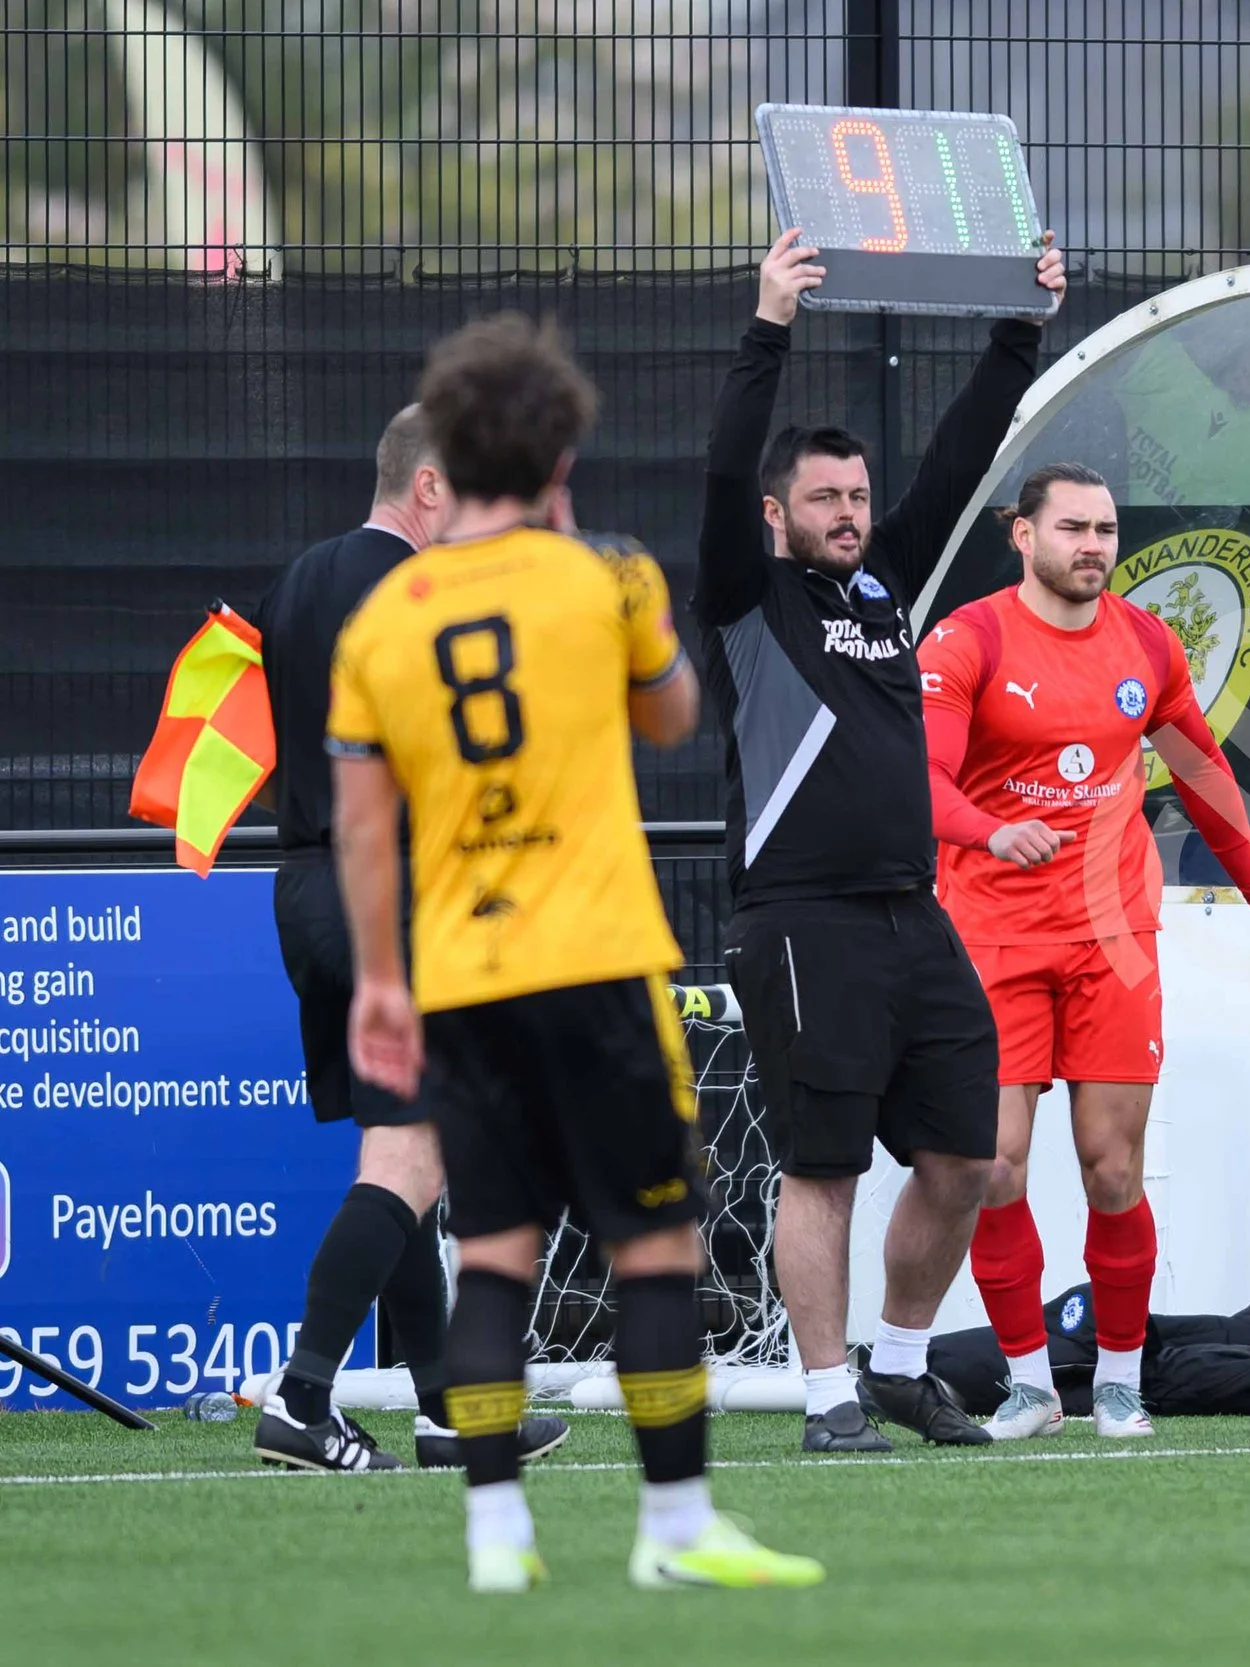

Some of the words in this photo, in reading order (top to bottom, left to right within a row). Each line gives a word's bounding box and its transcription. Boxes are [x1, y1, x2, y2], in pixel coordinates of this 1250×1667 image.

[831, 119, 908, 252] 9
[433, 614, 526, 765] 8
[1002, 776, 1070, 800] Andrew
[3, 905, 58, 943] and
[67, 904, 141, 942] build
[33, 962, 95, 1006] gain
[0, 1018, 140, 1062] cquisition
[33, 1071, 230, 1116] development
[239, 1070, 307, 1106] servi
[51, 1189, 277, 1249] Payehomes
[126, 1322, 302, 1396] 5340
